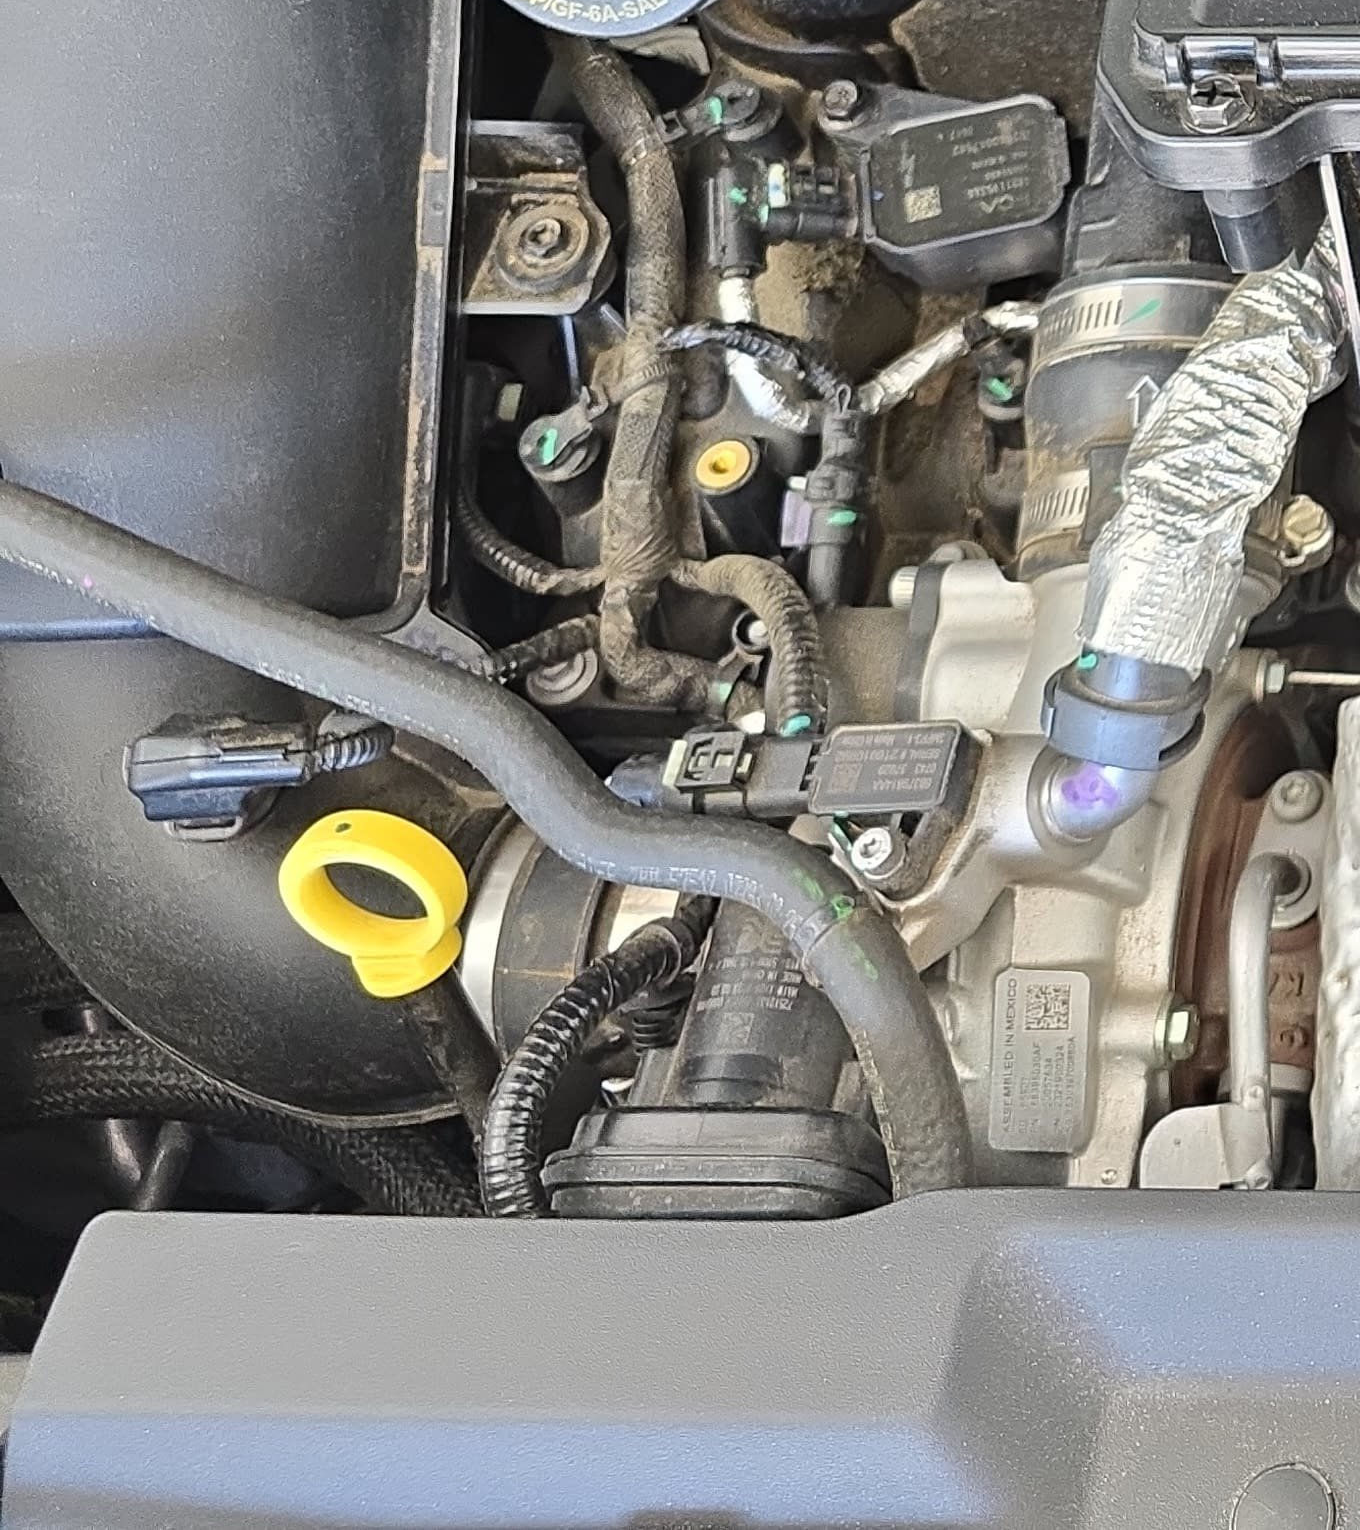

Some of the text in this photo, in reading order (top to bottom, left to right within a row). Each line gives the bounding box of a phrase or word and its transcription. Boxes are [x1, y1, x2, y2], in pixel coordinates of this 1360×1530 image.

[1001, 978, 1018, 1133] ASSEMBLED IN MEXICO
